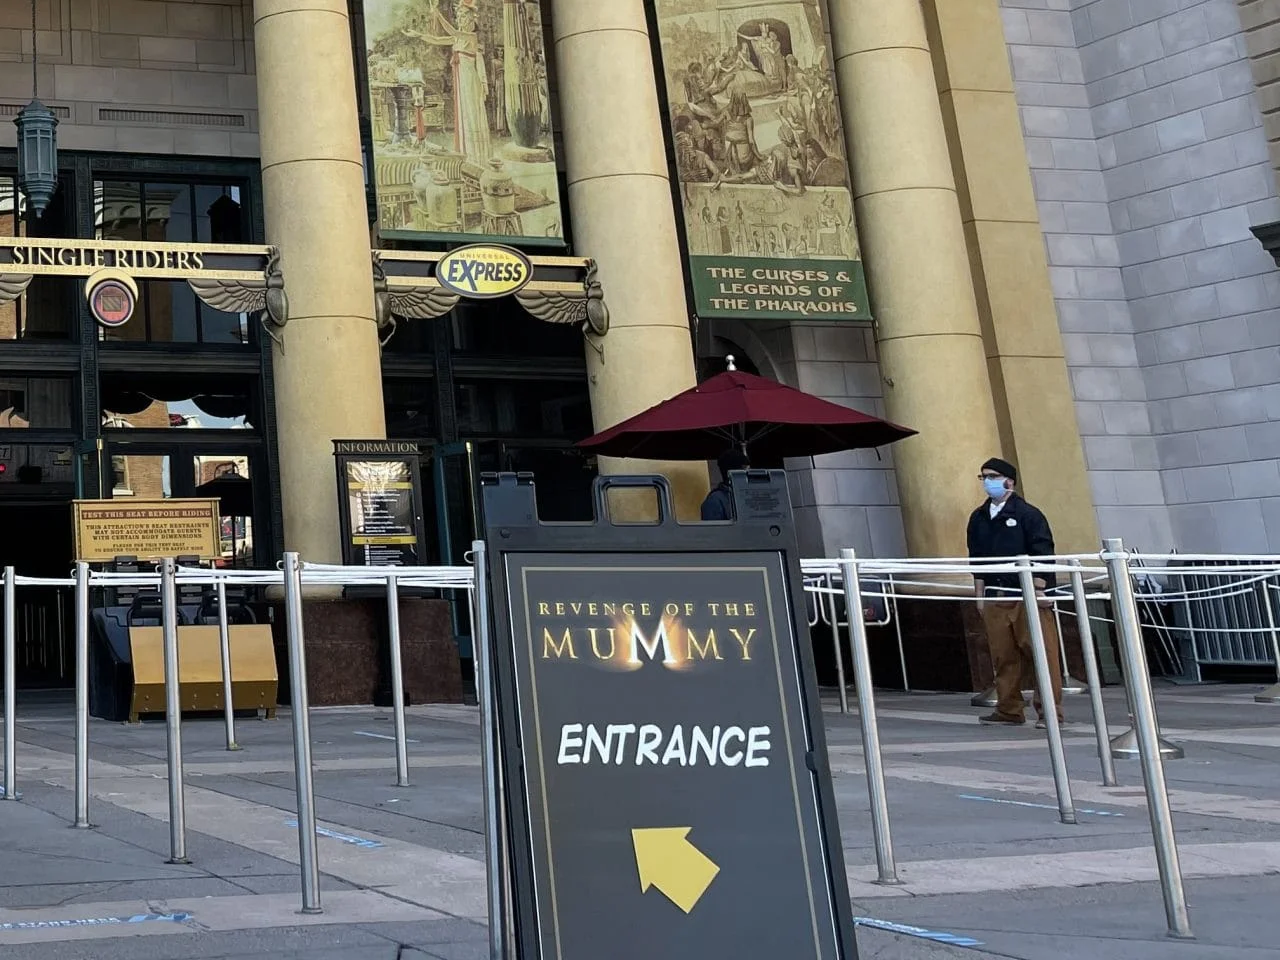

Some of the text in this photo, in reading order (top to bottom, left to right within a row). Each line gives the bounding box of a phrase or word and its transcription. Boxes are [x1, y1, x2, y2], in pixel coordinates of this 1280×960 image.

[13, 246, 204, 270] SINGLE RIDERS
[448, 259, 522, 291] EXPRESS
[706, 267, 852, 284] THE CURSES &
[719, 283, 843, 297] LEGENDS OF
[709, 298, 857, 315] THE PHARAOHS
[337, 443, 418, 452] INFORMATION
[83, 511, 103, 519] TEST
[126, 510, 146, 518] SEAT
[148, 510, 179, 518] BEFORE
[182, 509, 211, 517] RIDING
[538, 601, 755, 616] REVENGE OF THE
[542, 618, 757, 664] MUMMY
[557, 723, 771, 767] ENTRANCE
